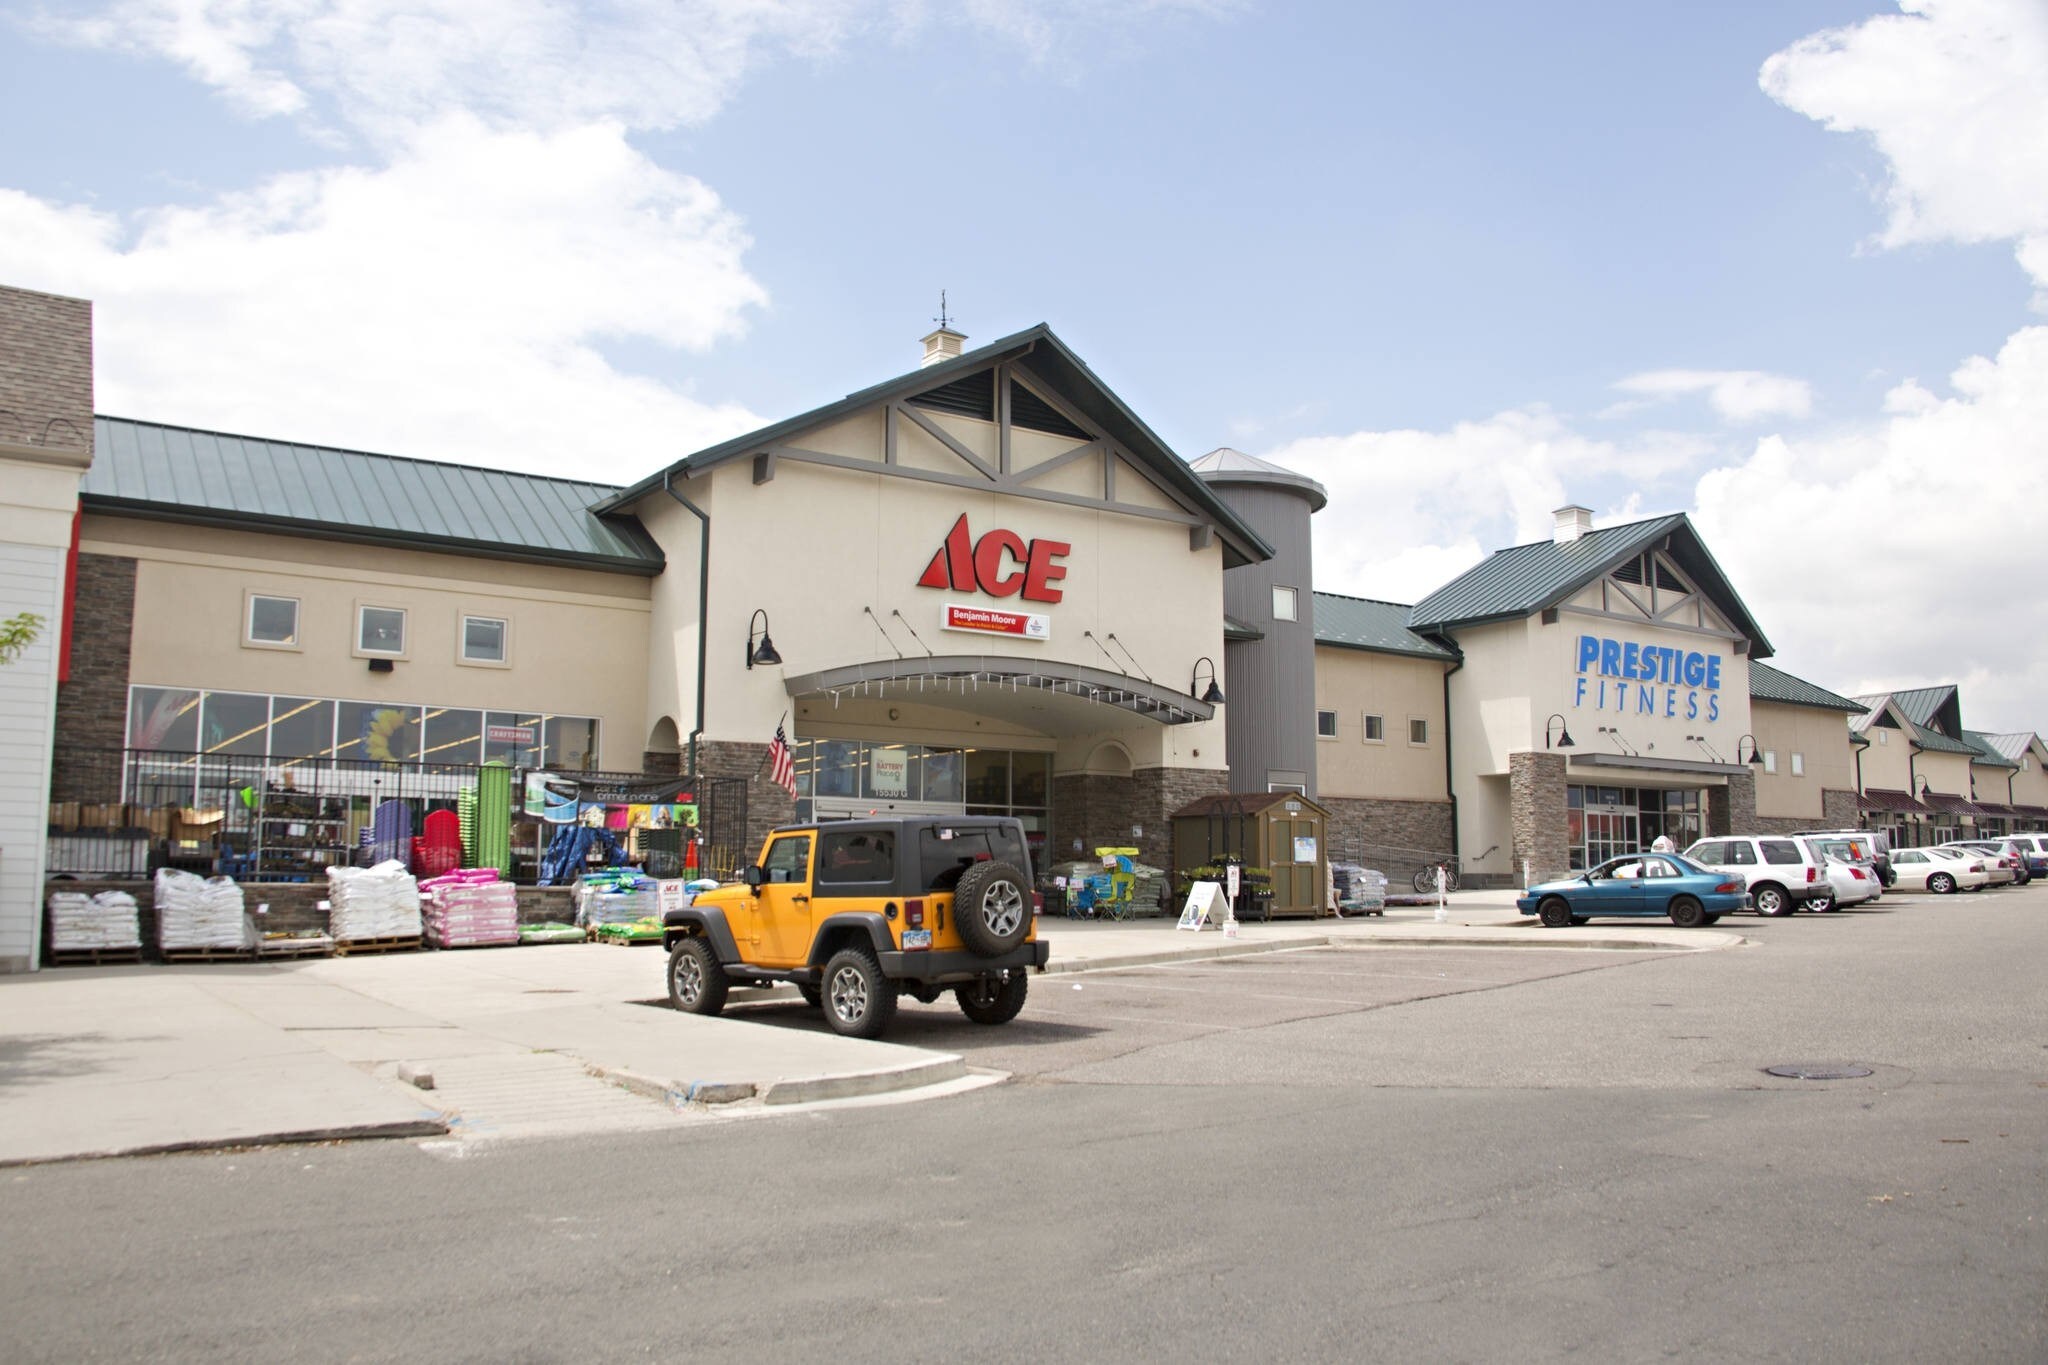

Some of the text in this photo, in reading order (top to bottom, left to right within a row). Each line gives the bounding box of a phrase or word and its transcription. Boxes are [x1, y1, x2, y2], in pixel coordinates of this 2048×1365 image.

[916, 512, 1071, 604] ACE
[954, 609, 990, 622] Benjamin
[992, 614, 1016, 625] Moore
[1577, 635, 1721, 690] PRESTIGE
[1575, 678, 1719, 722] FITNESS
